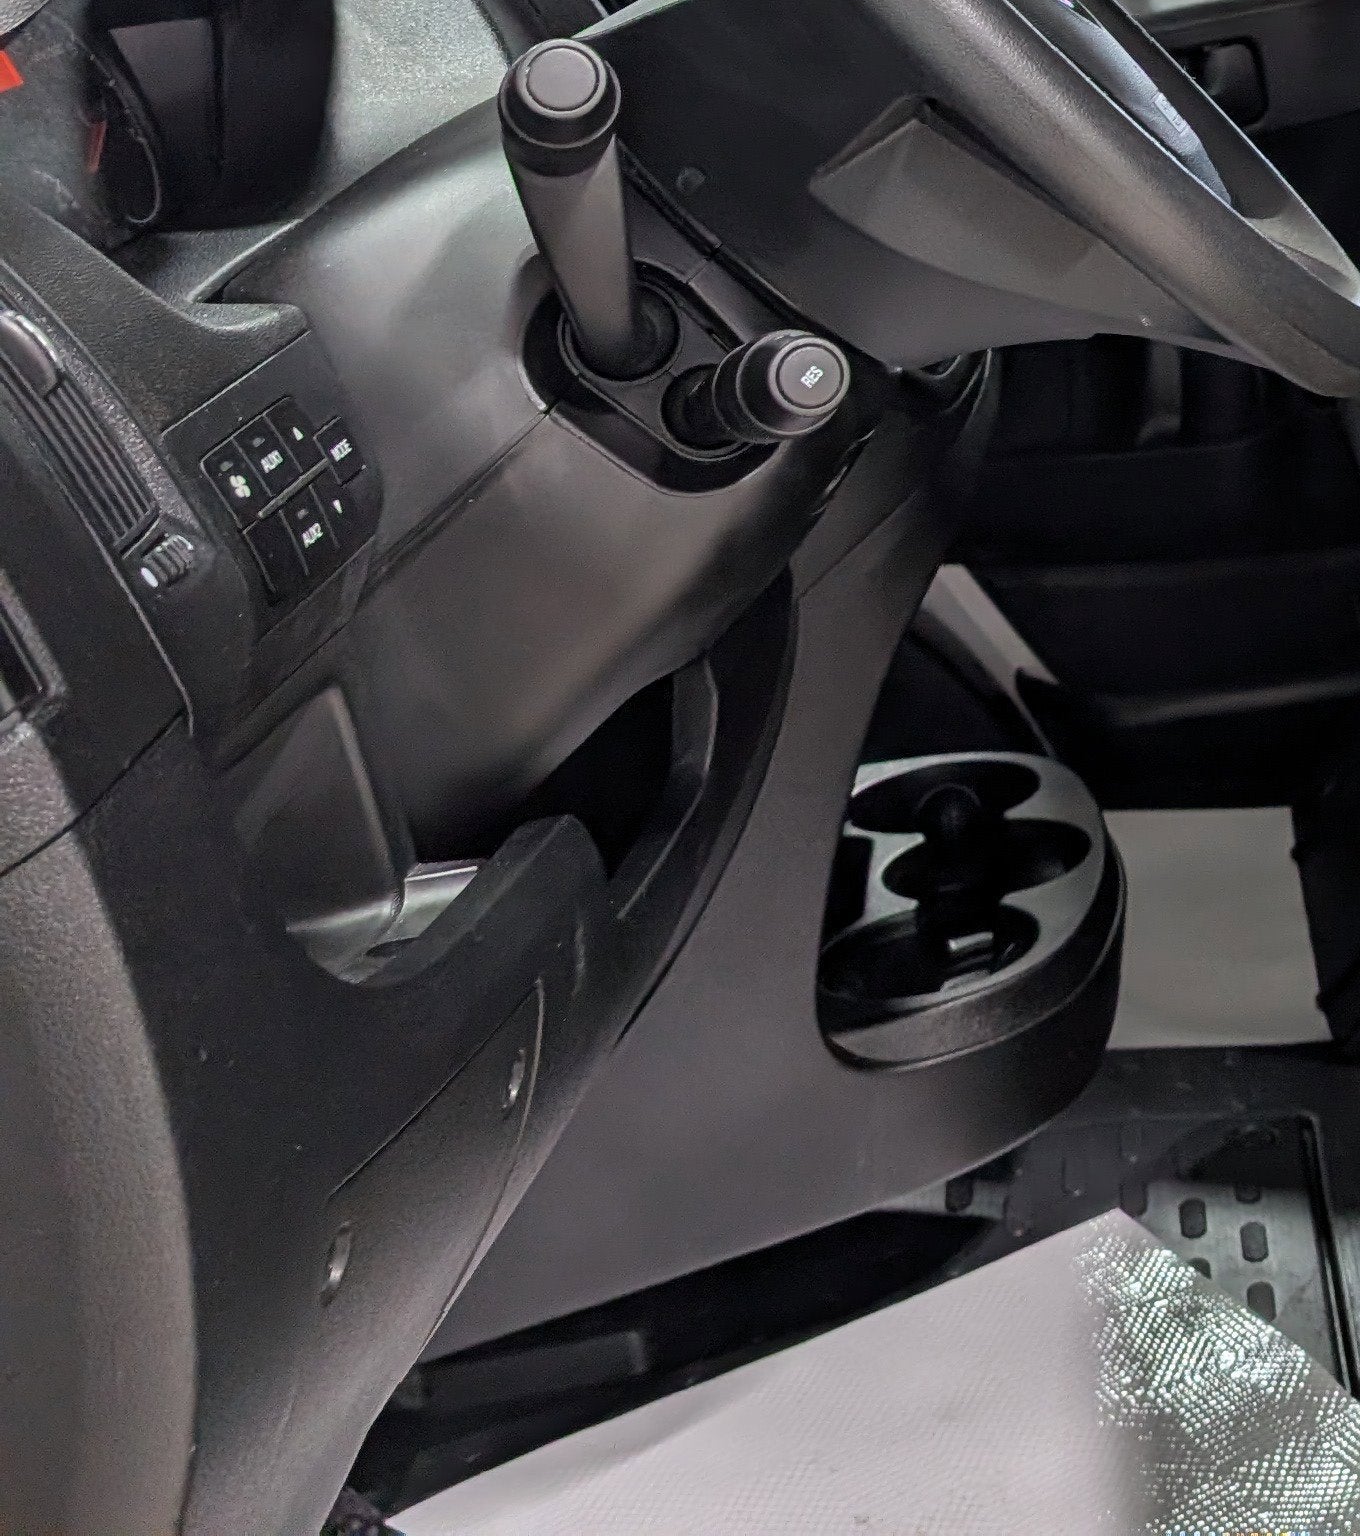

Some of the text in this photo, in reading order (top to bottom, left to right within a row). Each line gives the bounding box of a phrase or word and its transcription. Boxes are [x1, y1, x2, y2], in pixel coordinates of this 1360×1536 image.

[800, 365, 824, 389] RES
[260, 449, 284, 474] AUX1
[301, 522, 324, 548] AUX2
